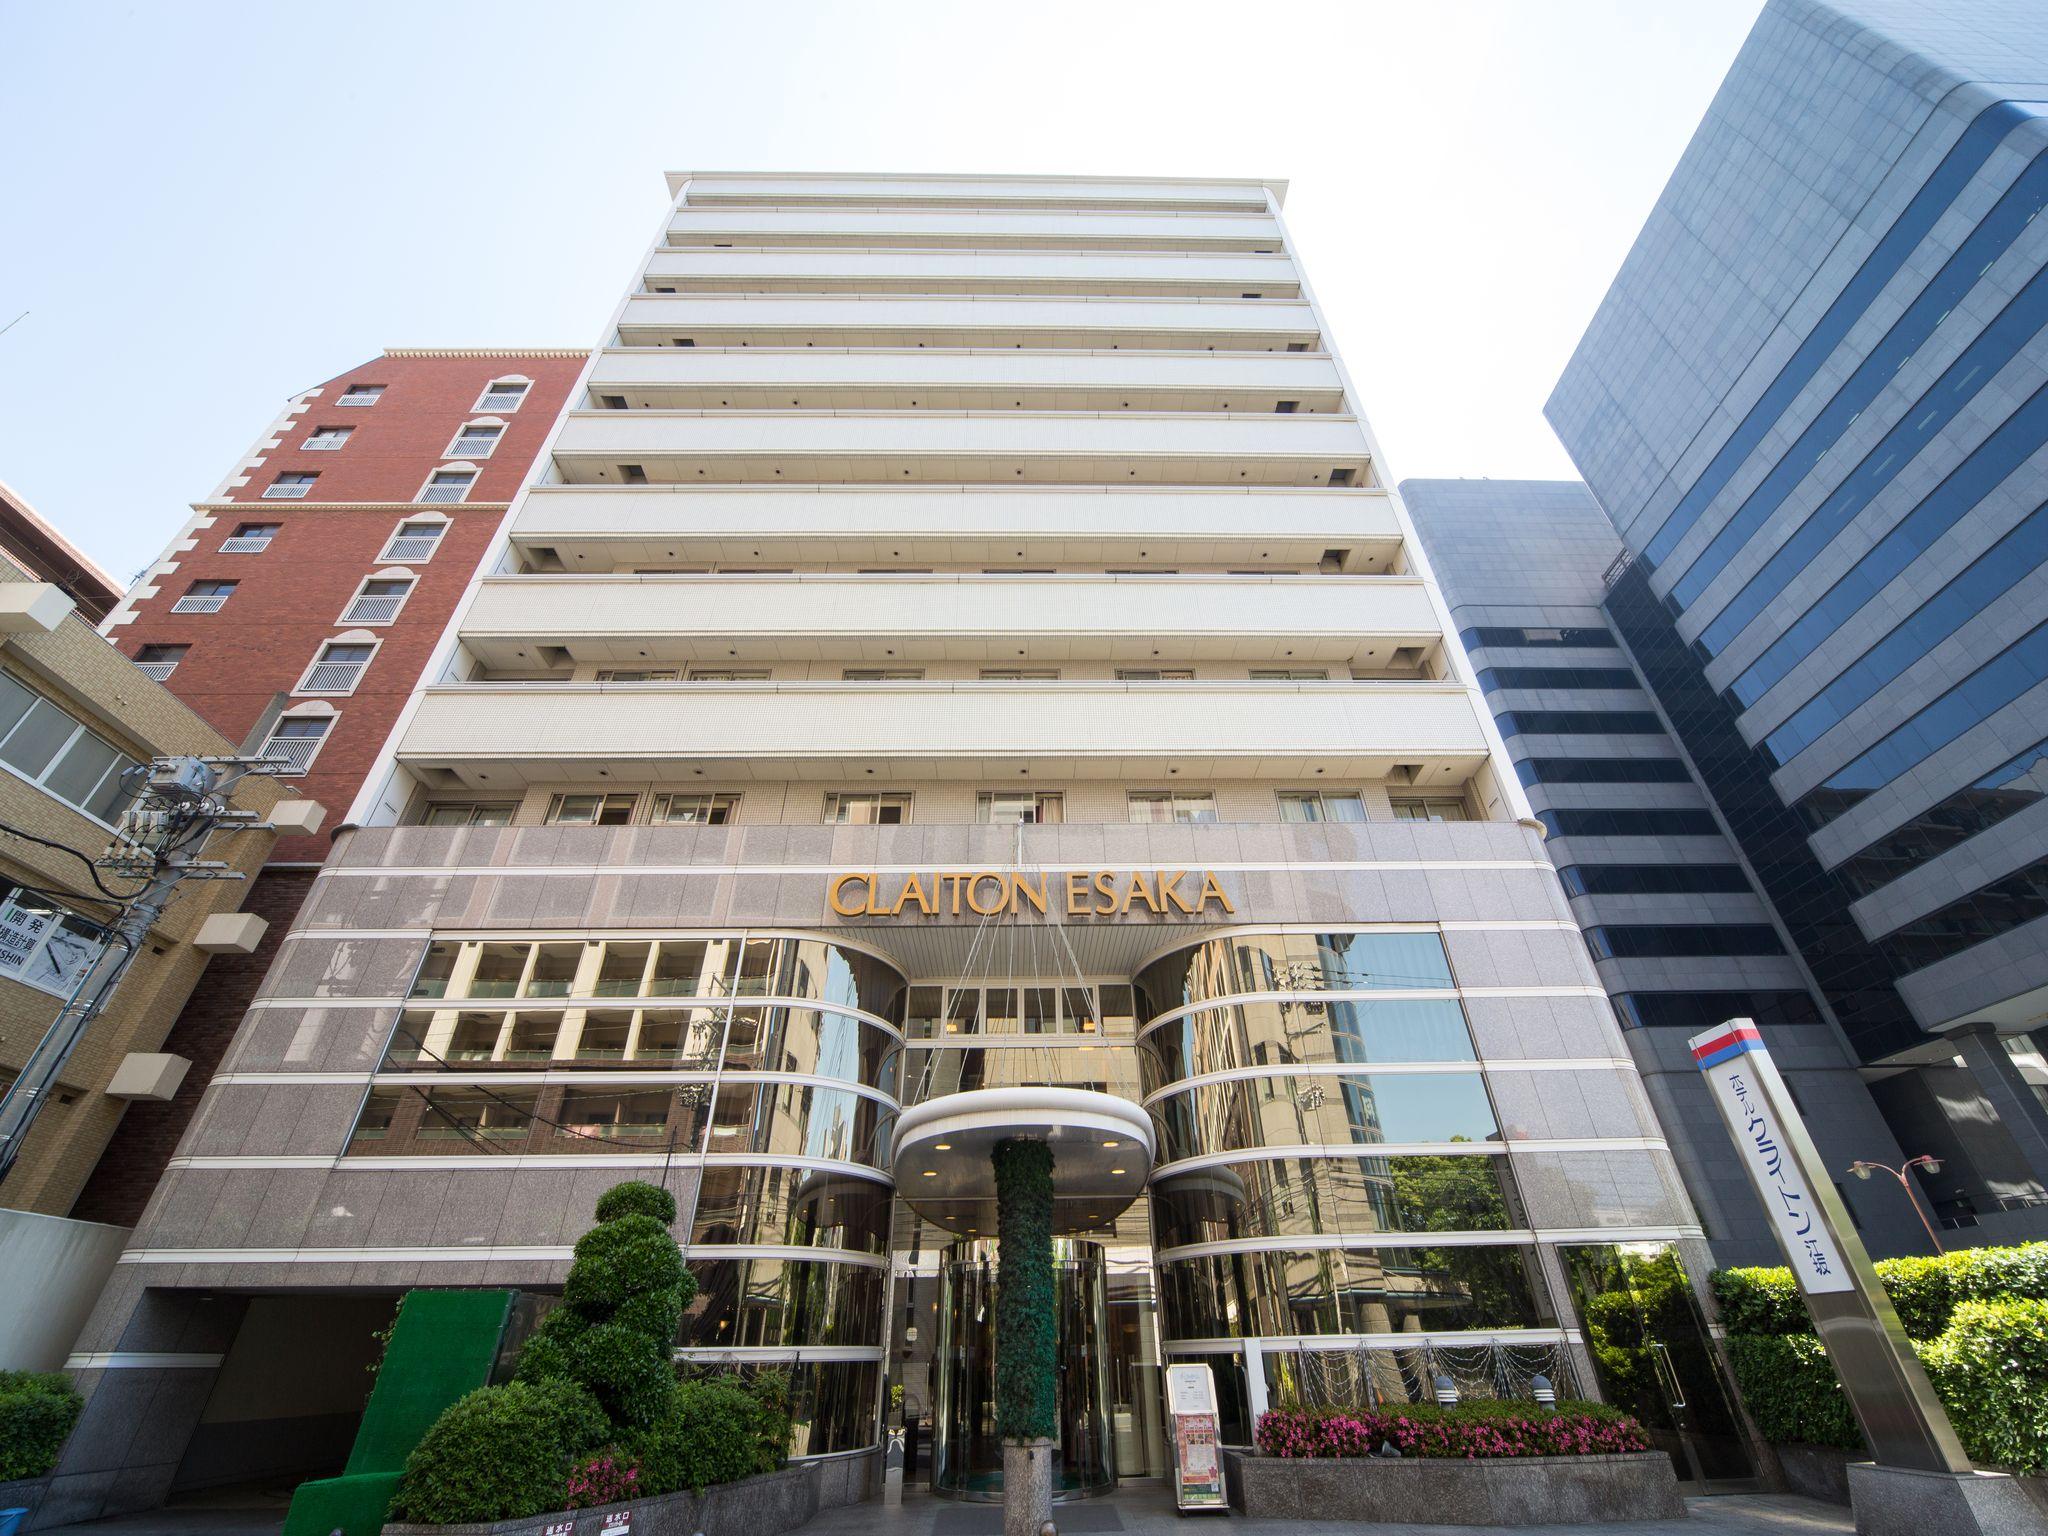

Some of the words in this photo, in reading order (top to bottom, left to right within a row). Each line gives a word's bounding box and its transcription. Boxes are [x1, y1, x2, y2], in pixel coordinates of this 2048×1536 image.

[829, 871, 1048, 916] CLAITON
[1066, 871, 1236, 916] ESAKA
[0, 924, 37, 952] 構造計算
[0, 949, 25, 967] SHIN
